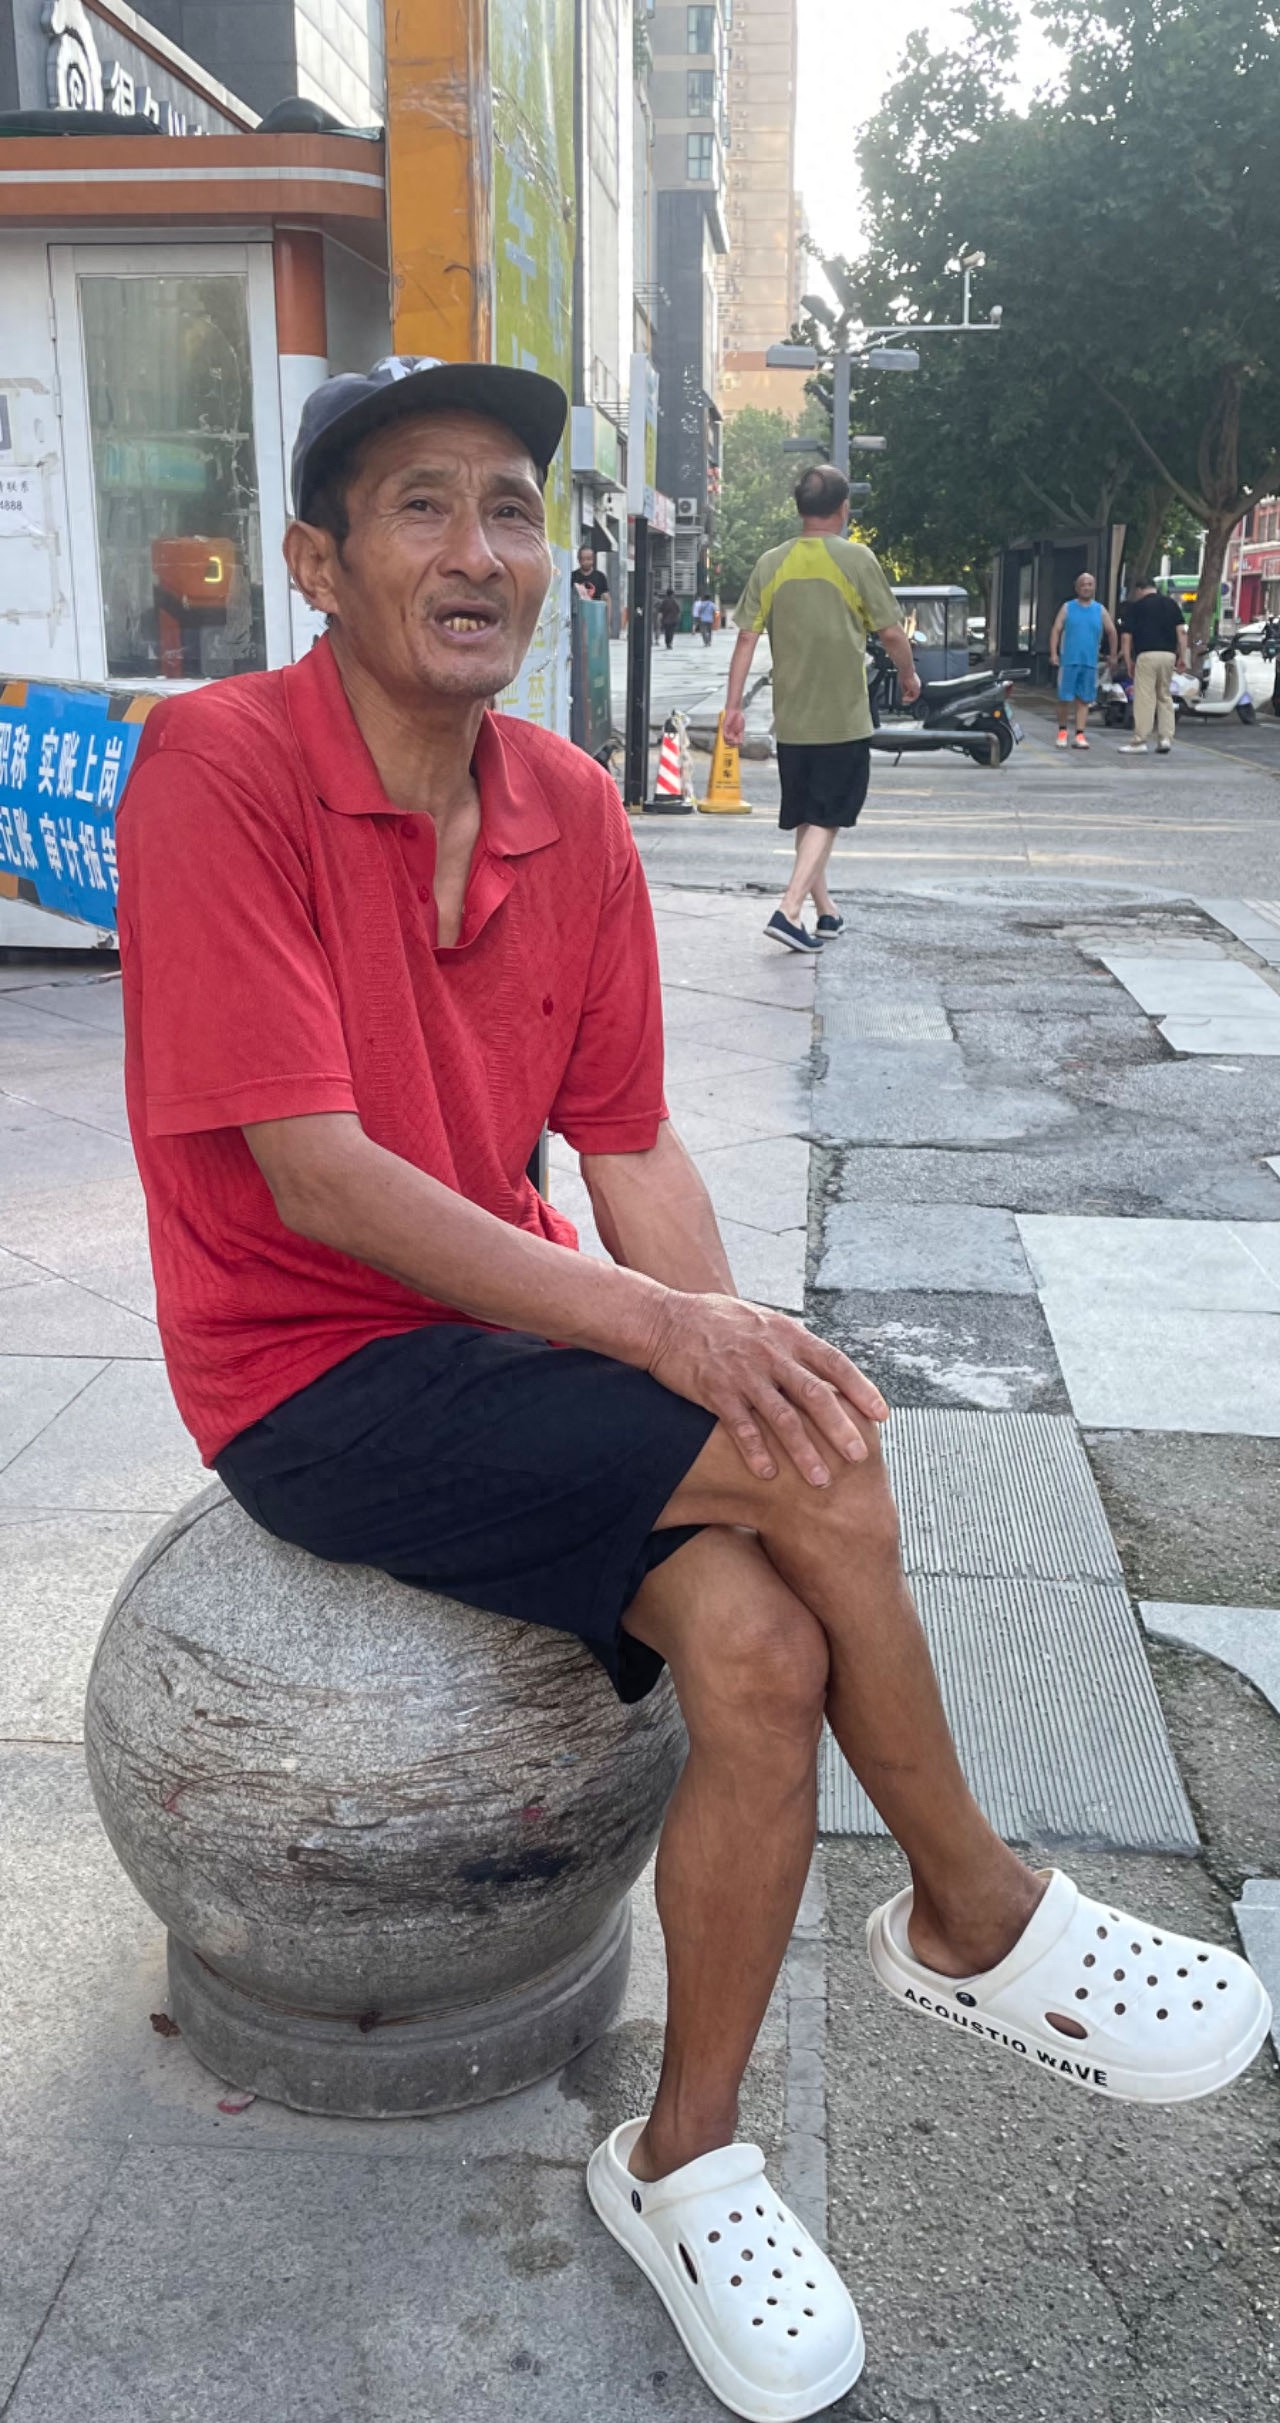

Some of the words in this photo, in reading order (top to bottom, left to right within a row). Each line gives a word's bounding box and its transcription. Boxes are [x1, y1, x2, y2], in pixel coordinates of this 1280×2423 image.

[37, 727, 123, 810] 实账上岗
[0, 805, 39, 871] 记账
[39, 811, 119, 896] 审计报告
[1036, 2049, 1109, 2088] WAVE
